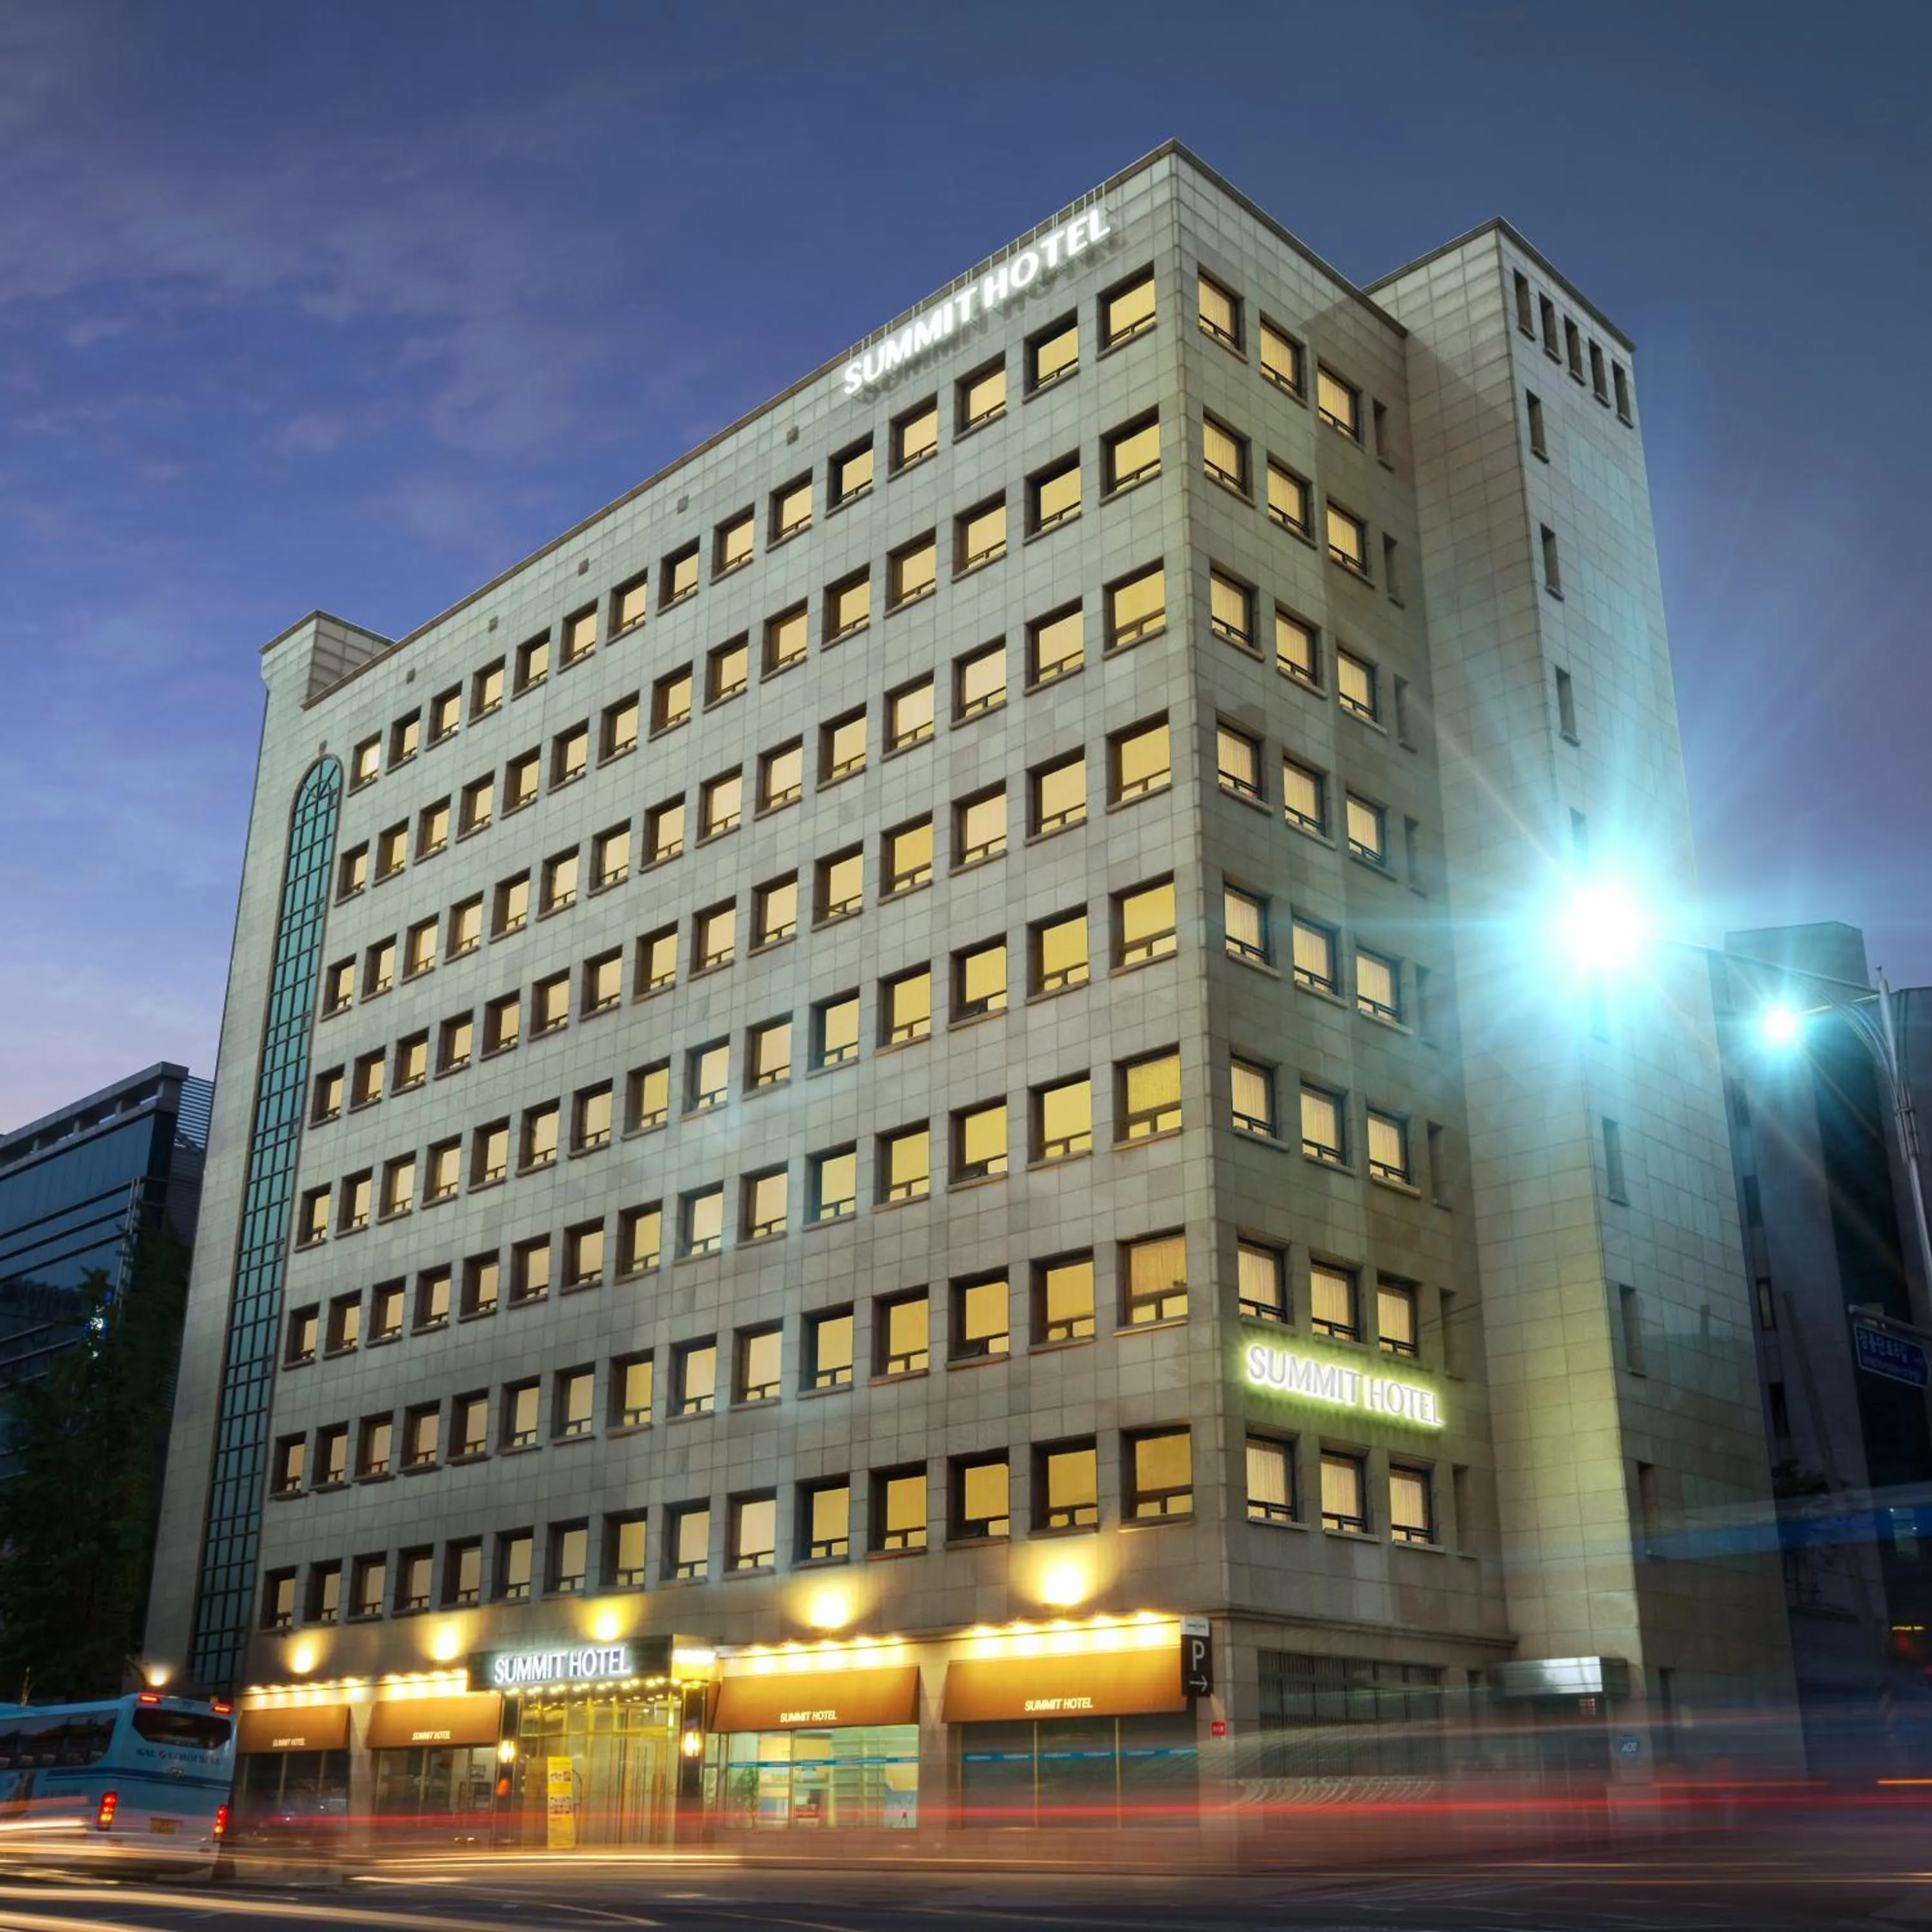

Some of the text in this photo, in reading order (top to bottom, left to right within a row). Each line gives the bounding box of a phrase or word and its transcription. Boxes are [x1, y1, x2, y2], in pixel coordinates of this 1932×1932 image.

[844, 209, 1111, 395] SUMMIT HOTEL
[1248, 1345, 1445, 1426] SUMMIT HOTEL
[494, 1646, 631, 1684] SUMMIT HOTEL
[1193, 1640, 1205, 1671] P
[780, 1710, 838, 1723] SUMMIT HOTEL
[1025, 1697, 1094, 1711] SUMMIT HOTEL
